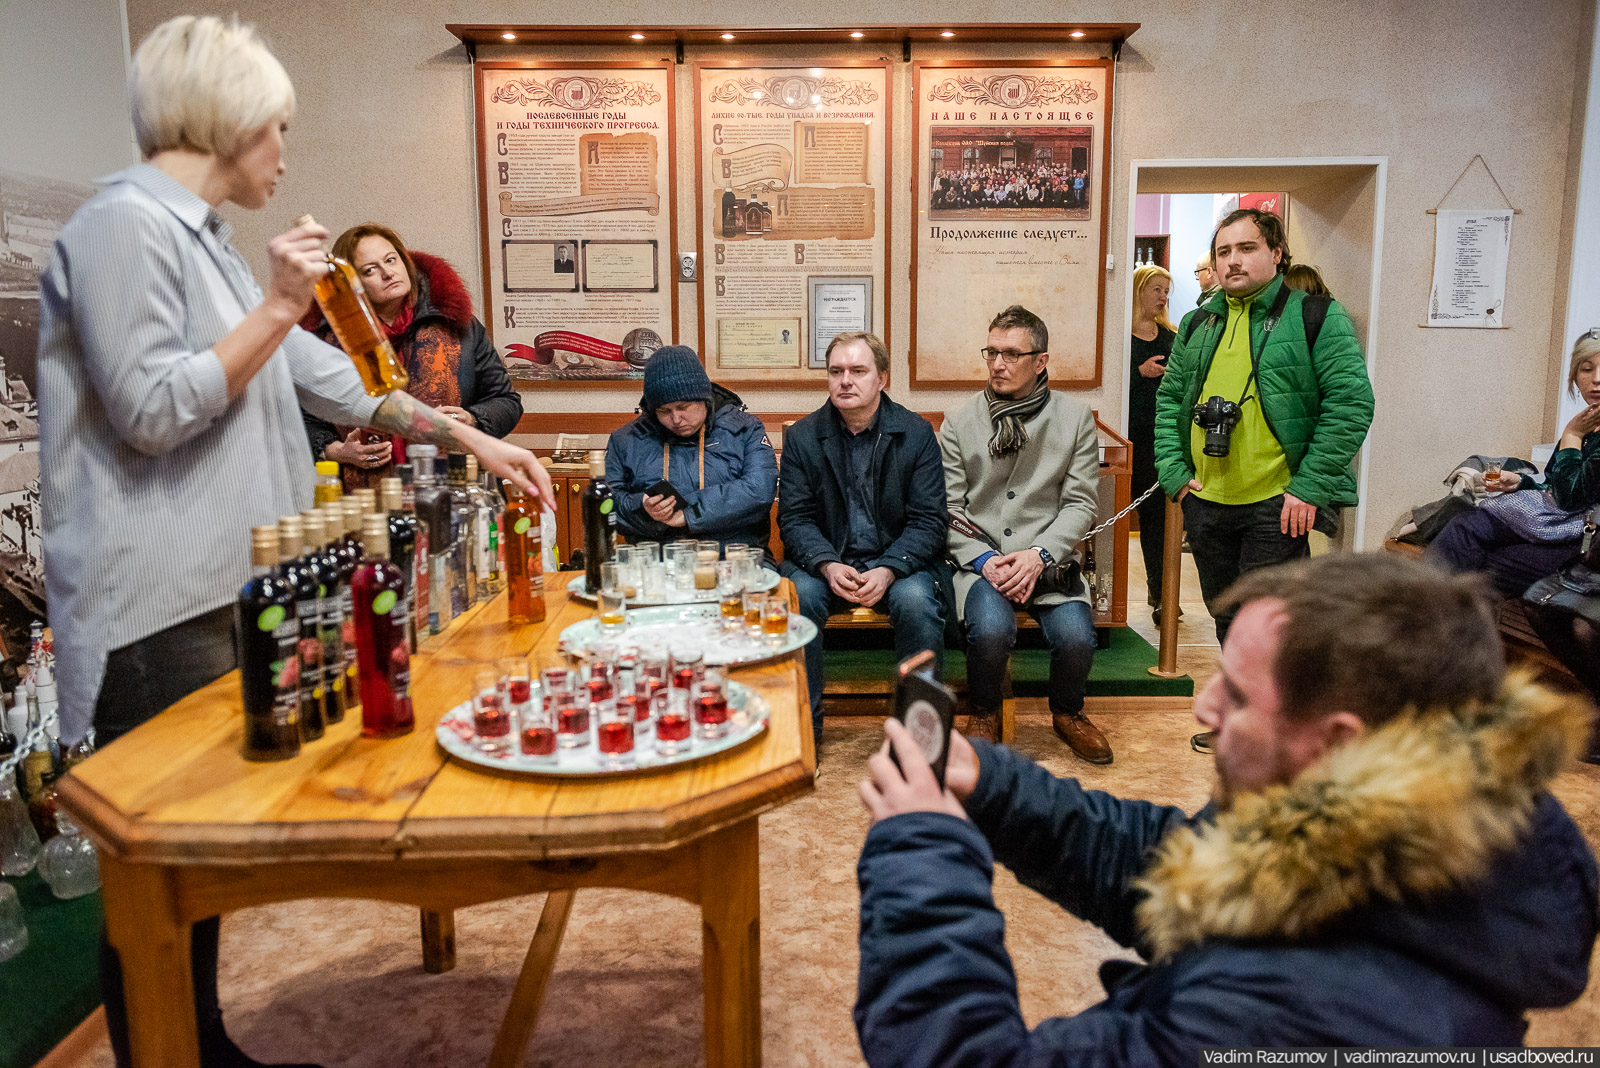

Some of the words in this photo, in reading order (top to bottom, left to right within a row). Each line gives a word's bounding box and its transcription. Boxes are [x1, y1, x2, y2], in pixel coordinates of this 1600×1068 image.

[602, 112, 627, 120] ГОДЫ
[766, 112, 785, 120] ГОДЫ
[787, 112, 814, 120] УПАДКА
[823, 112, 876, 120] ВОЗРОЖДЕНИЯ.
[931, 111, 977, 121] НАШЕ
[990, 111, 1094, 122] НАСТОЯЩЕЕ
[496, 121, 503, 129] И
[506, 121, 530, 130] ГОДЫ
[533, 121, 605, 130] ТЕХНИЧЕСКОГО
[607, 121, 660, 129] ПРОГРЕССА.
[929, 226, 1018, 241] Продолжение
[1023, 229, 1089, 242] следует...
[952, 519, 973, 535] Canon
